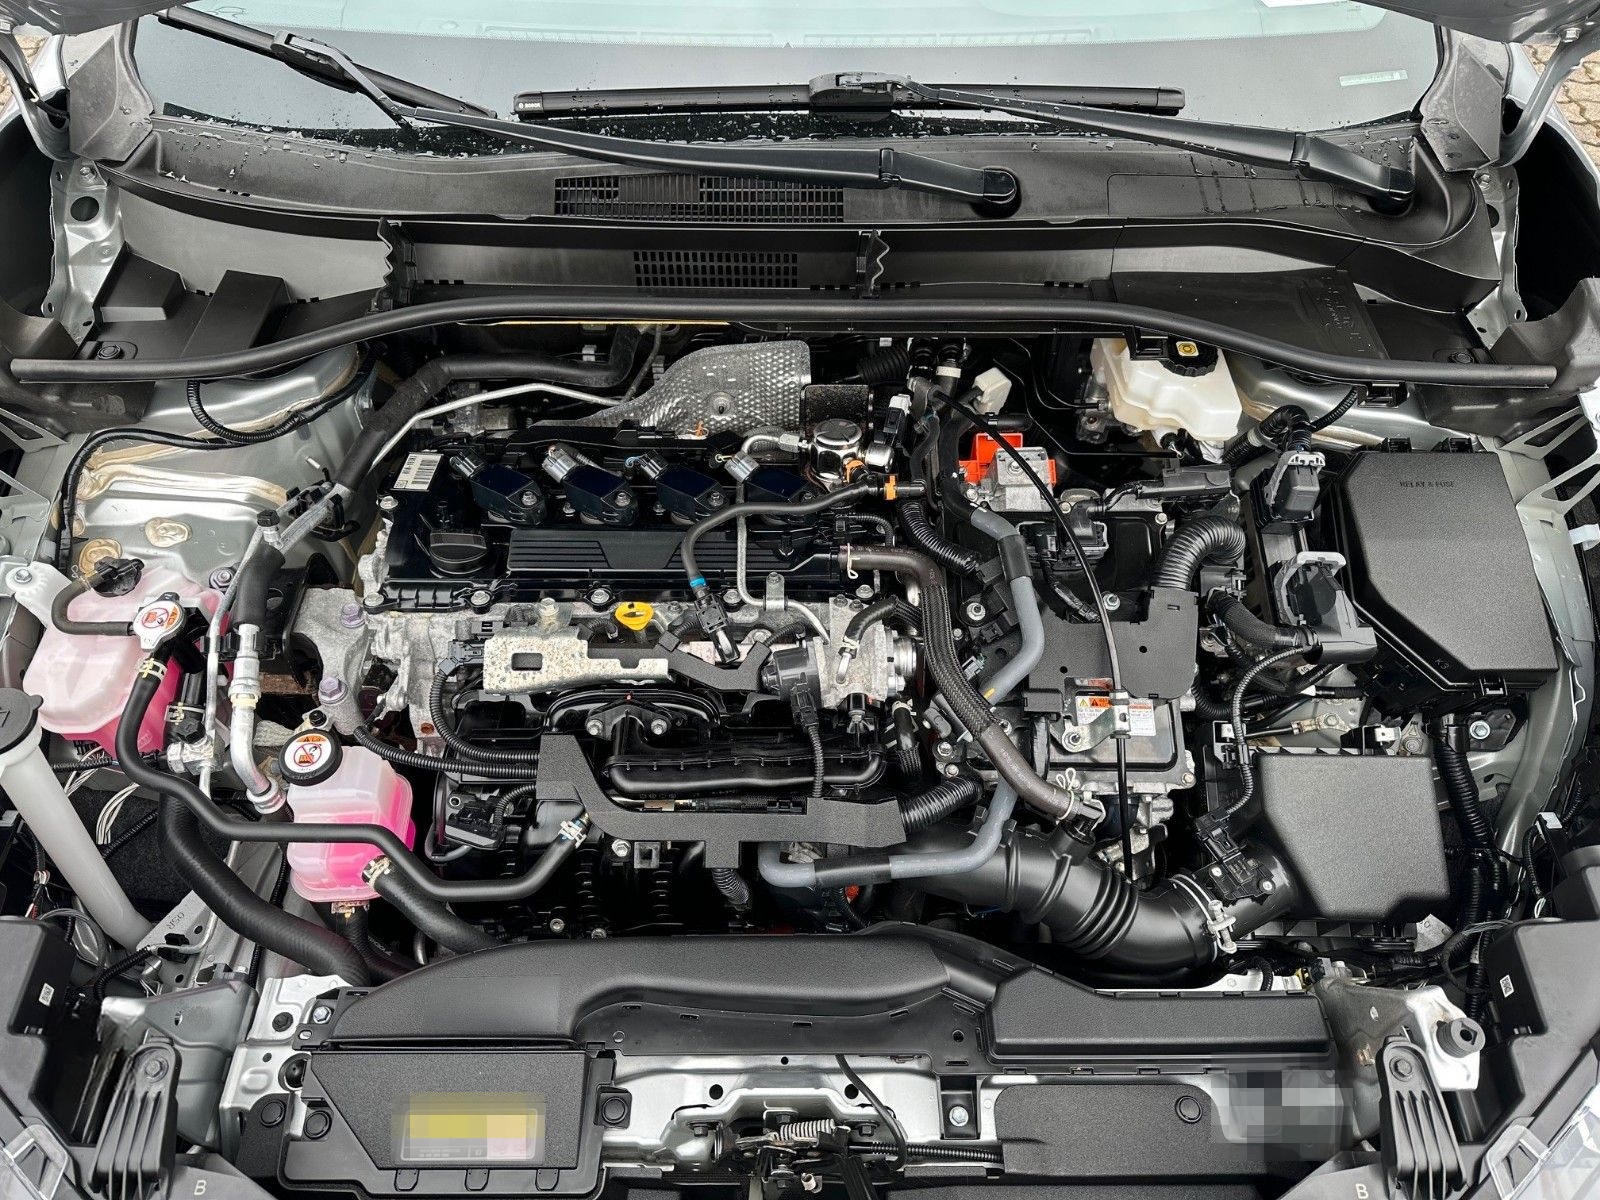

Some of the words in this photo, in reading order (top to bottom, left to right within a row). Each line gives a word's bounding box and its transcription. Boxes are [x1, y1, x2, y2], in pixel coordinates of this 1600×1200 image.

[1400, 480, 1425, 488] RELAY
[1435, 480, 1454, 488] FUSE
[193, 1179, 206, 1196] B
[1355, 1183, 1369, 1199] B
